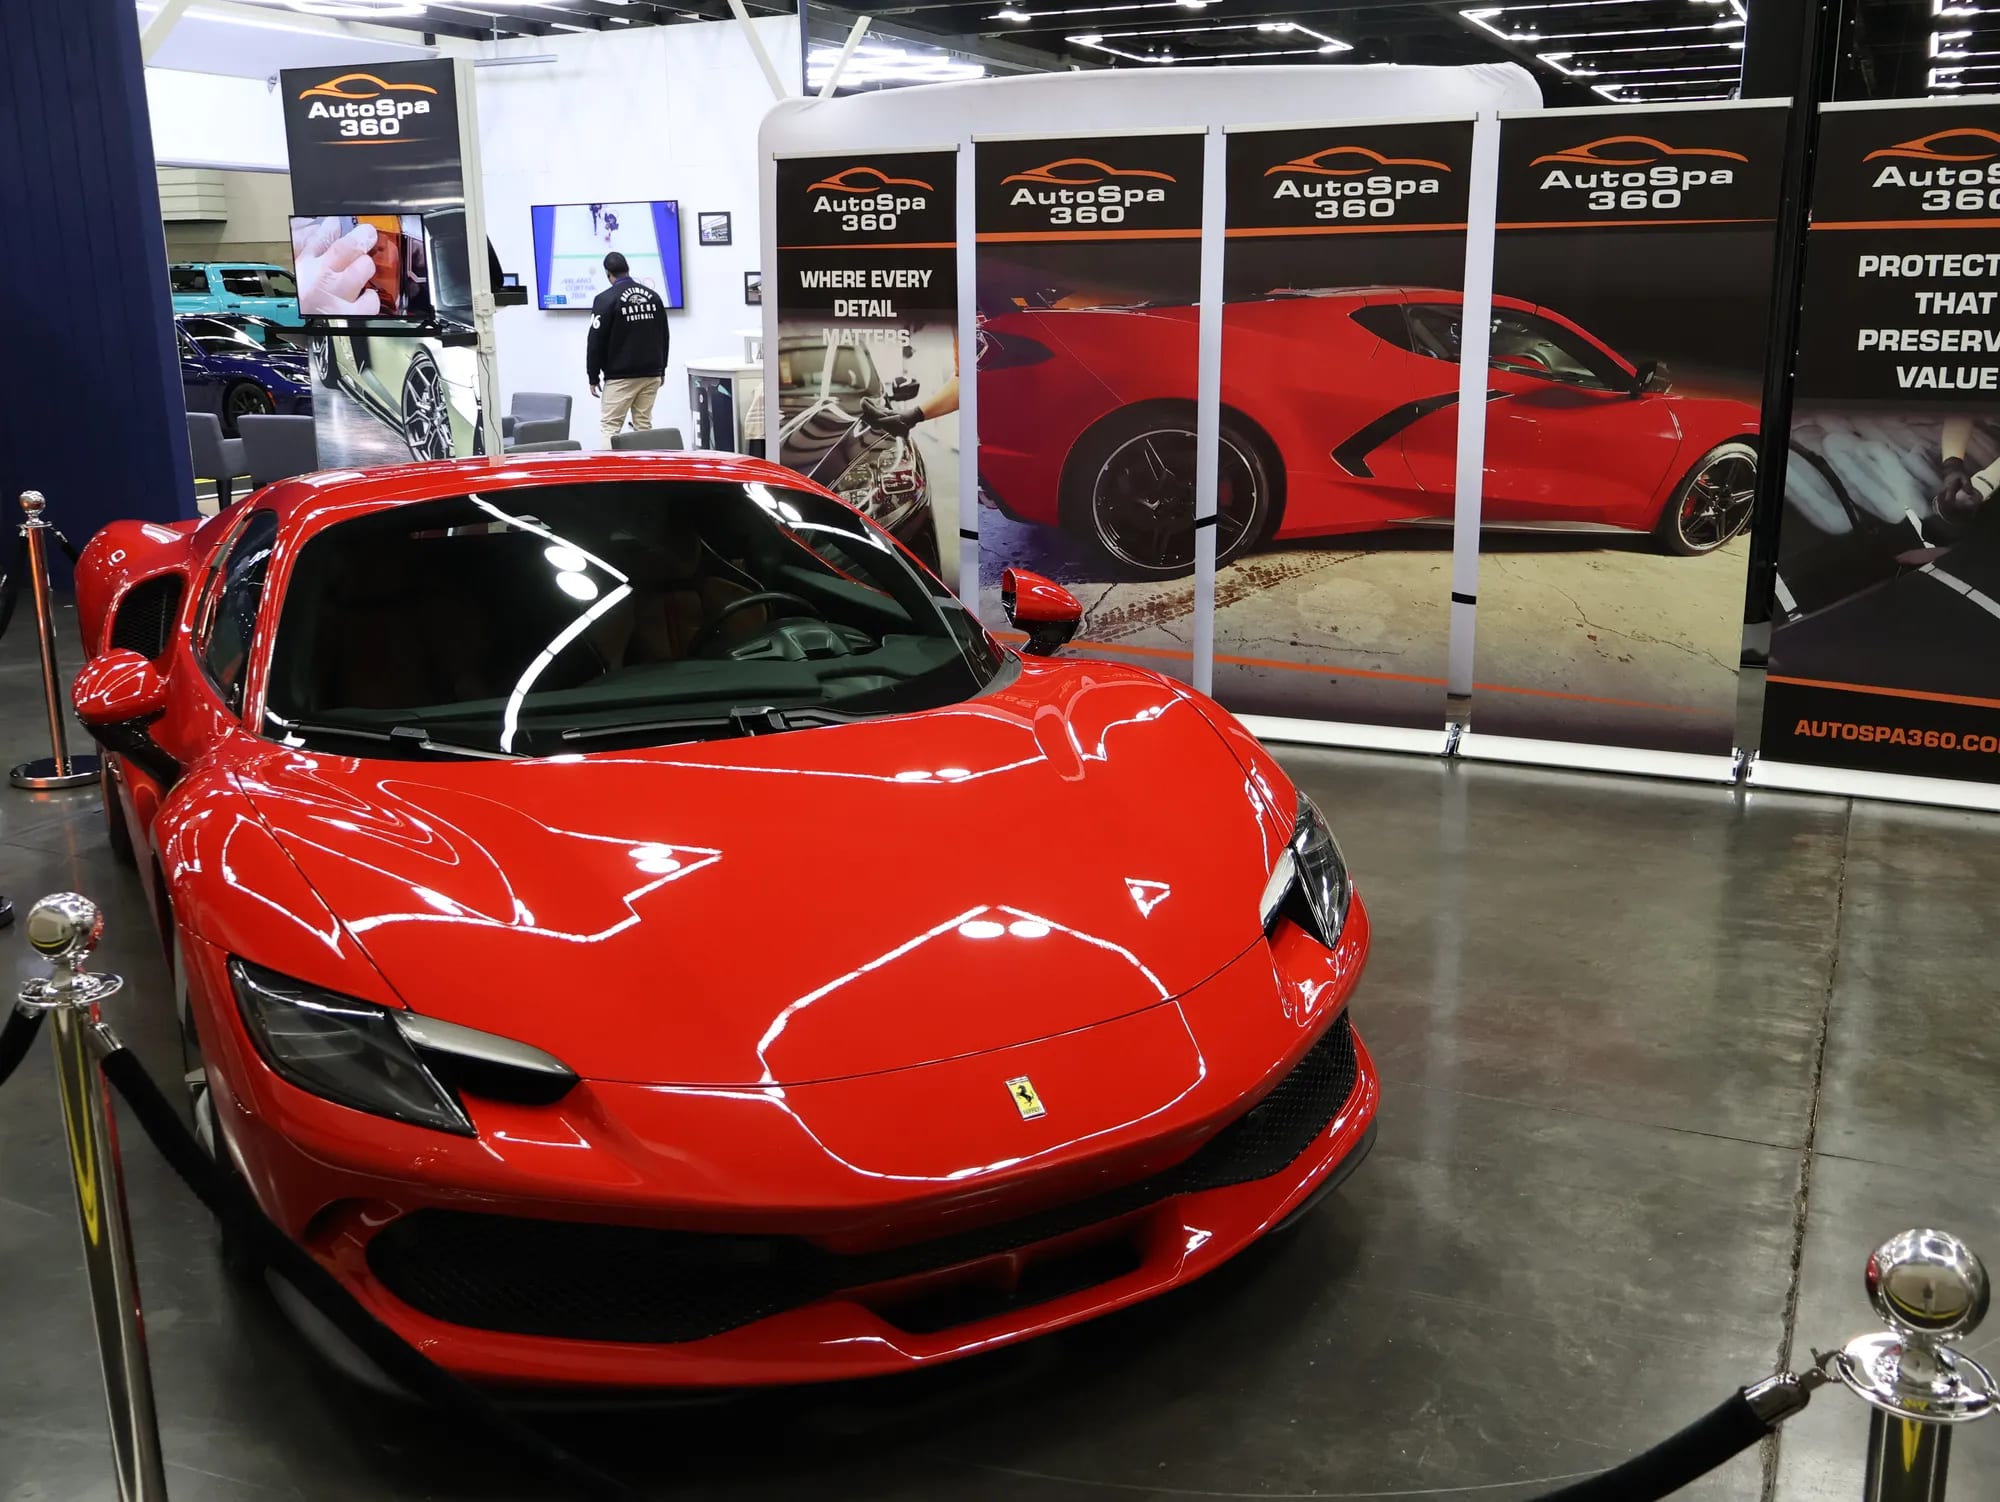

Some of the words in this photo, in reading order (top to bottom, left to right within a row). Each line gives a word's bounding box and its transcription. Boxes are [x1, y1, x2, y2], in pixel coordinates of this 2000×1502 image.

[307, 98, 430, 120] AutoSpa
[339, 118, 400, 137] 360
[1273, 175, 1439, 201] AutoSpa
[1540, 166, 1733, 193] AutoSpa
[813, 193, 926, 214] AutoSpa
[1010, 185, 1165, 209] AutoSpa
[1588, 189, 1681, 210] 360
[1050, 205, 1125, 224] 360
[1315, 198, 1395, 219] 360
[842, 213, 897, 231] 360
[800, 270, 866, 288] WHERE
[871, 269, 933, 288] EVERY
[621, 303, 657, 316] RAVENS
[834, 299, 898, 318] DETAIL
[1914, 291, 1998, 315] THAT
[822, 328, 911, 347] MATTERS
[1896, 366, 1999, 390] VALUE
[1794, 719, 2000, 752] AUTOSPA360.CO
